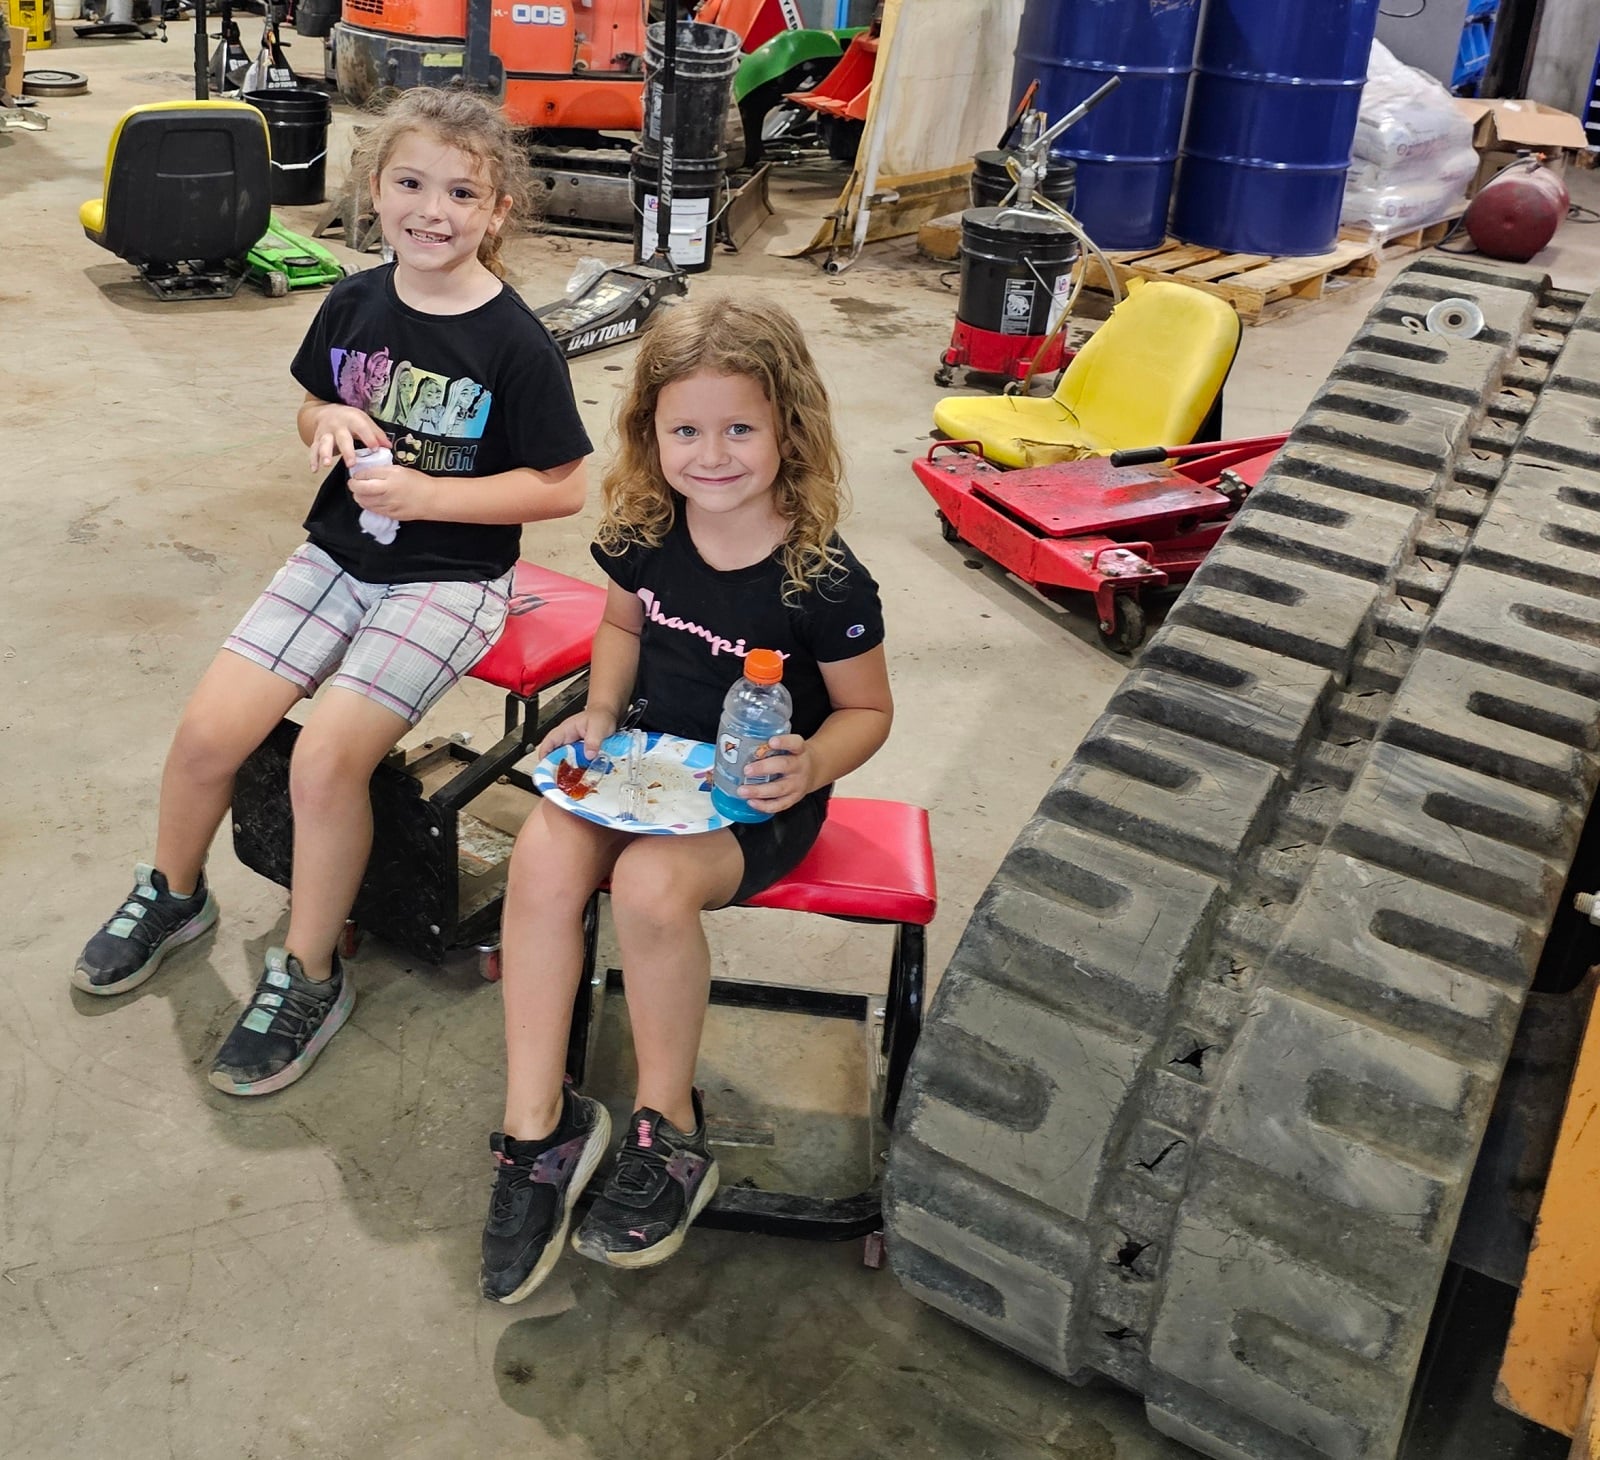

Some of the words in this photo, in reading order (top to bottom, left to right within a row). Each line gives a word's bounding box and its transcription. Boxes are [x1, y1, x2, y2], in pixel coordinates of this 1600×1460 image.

[661, 136, 674, 207] DAYTONA
[567, 318, 637, 351] DAYTONA
[421, 439, 478, 472] HIGH
[636, 587, 791, 660] hampi
